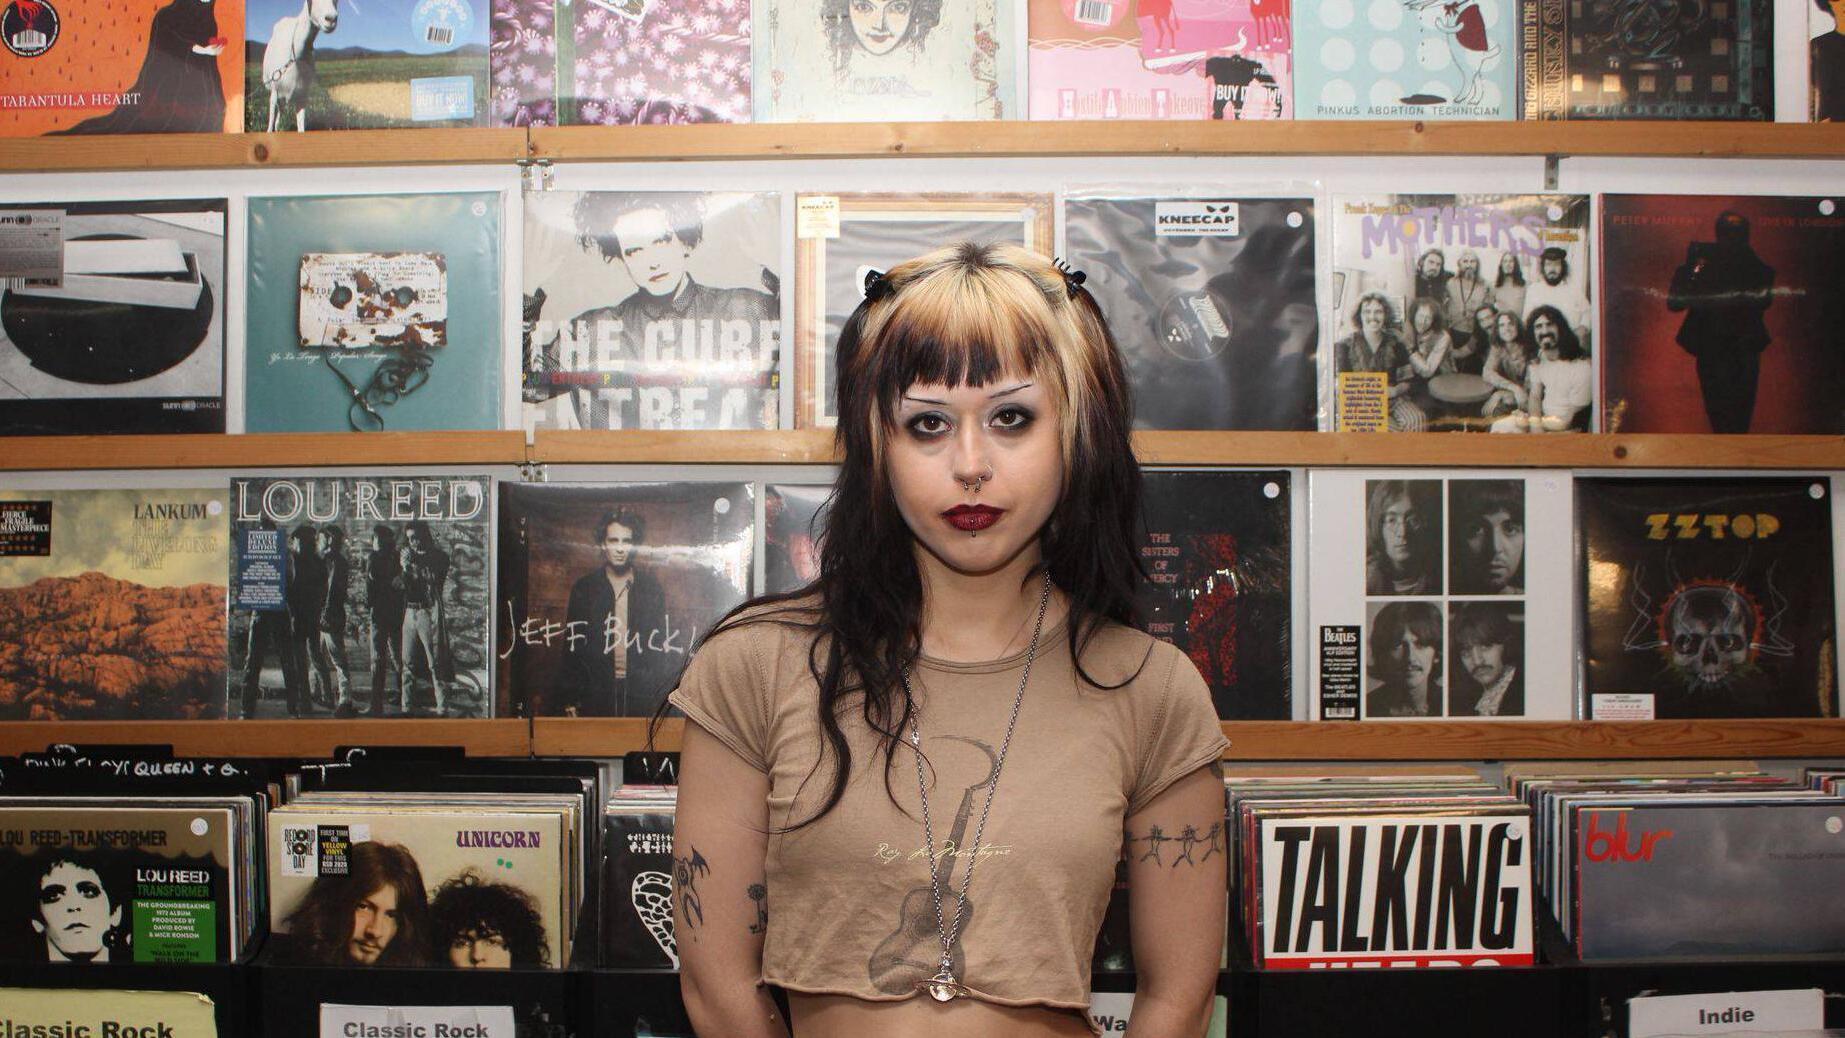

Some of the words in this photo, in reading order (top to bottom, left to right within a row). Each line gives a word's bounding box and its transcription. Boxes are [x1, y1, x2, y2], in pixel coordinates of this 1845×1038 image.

[1, 95, 86, 107] TARANTULA
[91, 93, 140, 105] HEART
[1216, 86, 1239, 101] BUY
[1317, 105, 1360, 115] PINKUS
[1368, 106, 1424, 116] ABORTION
[1432, 106, 1500, 116] TECHNICIAN
[1159, 215, 1235, 224] KNEECAP
[1361, 207, 1548, 260] MOTHERS
[237, 480, 342, 522] LOU
[355, 480, 483, 521] REED
[2, 510, 27, 519] FIERCE
[134, 503, 208, 520] LANKUM
[0, 523, 50, 533] MASTERPIECE
[4, 517, 35, 525] FRAGILE
[1151, 533, 1171, 543] THE
[1141, 546, 1180, 556] SISTERS
[1154, 560, 1169, 570] OF
[1148, 622, 1175, 633] FIRST
[1324, 628, 1357, 644] BEATLES
[134, 761, 196, 777] QUEEN
[0, 830, 24, 845] LOU
[456, 830, 541, 849] UNICORN
[1585, 811, 1675, 864] blur
[325, 848, 344, 856] VINYL
[136, 869, 167, 883] LOU
[169, 870, 210, 884] REED
[137, 884, 209, 897] TRANSFORMER
[1272, 823, 1523, 953] TALKING
[151, 902, 211, 910] GROUNDBREAKING
[1698, 1007, 1756, 1025] Indie
[0, 1020, 91, 1038] lassic
[101, 1021, 174, 1038] Rock
[343, 1022, 427, 1038] Classic
[434, 1023, 489, 1038] Rock
